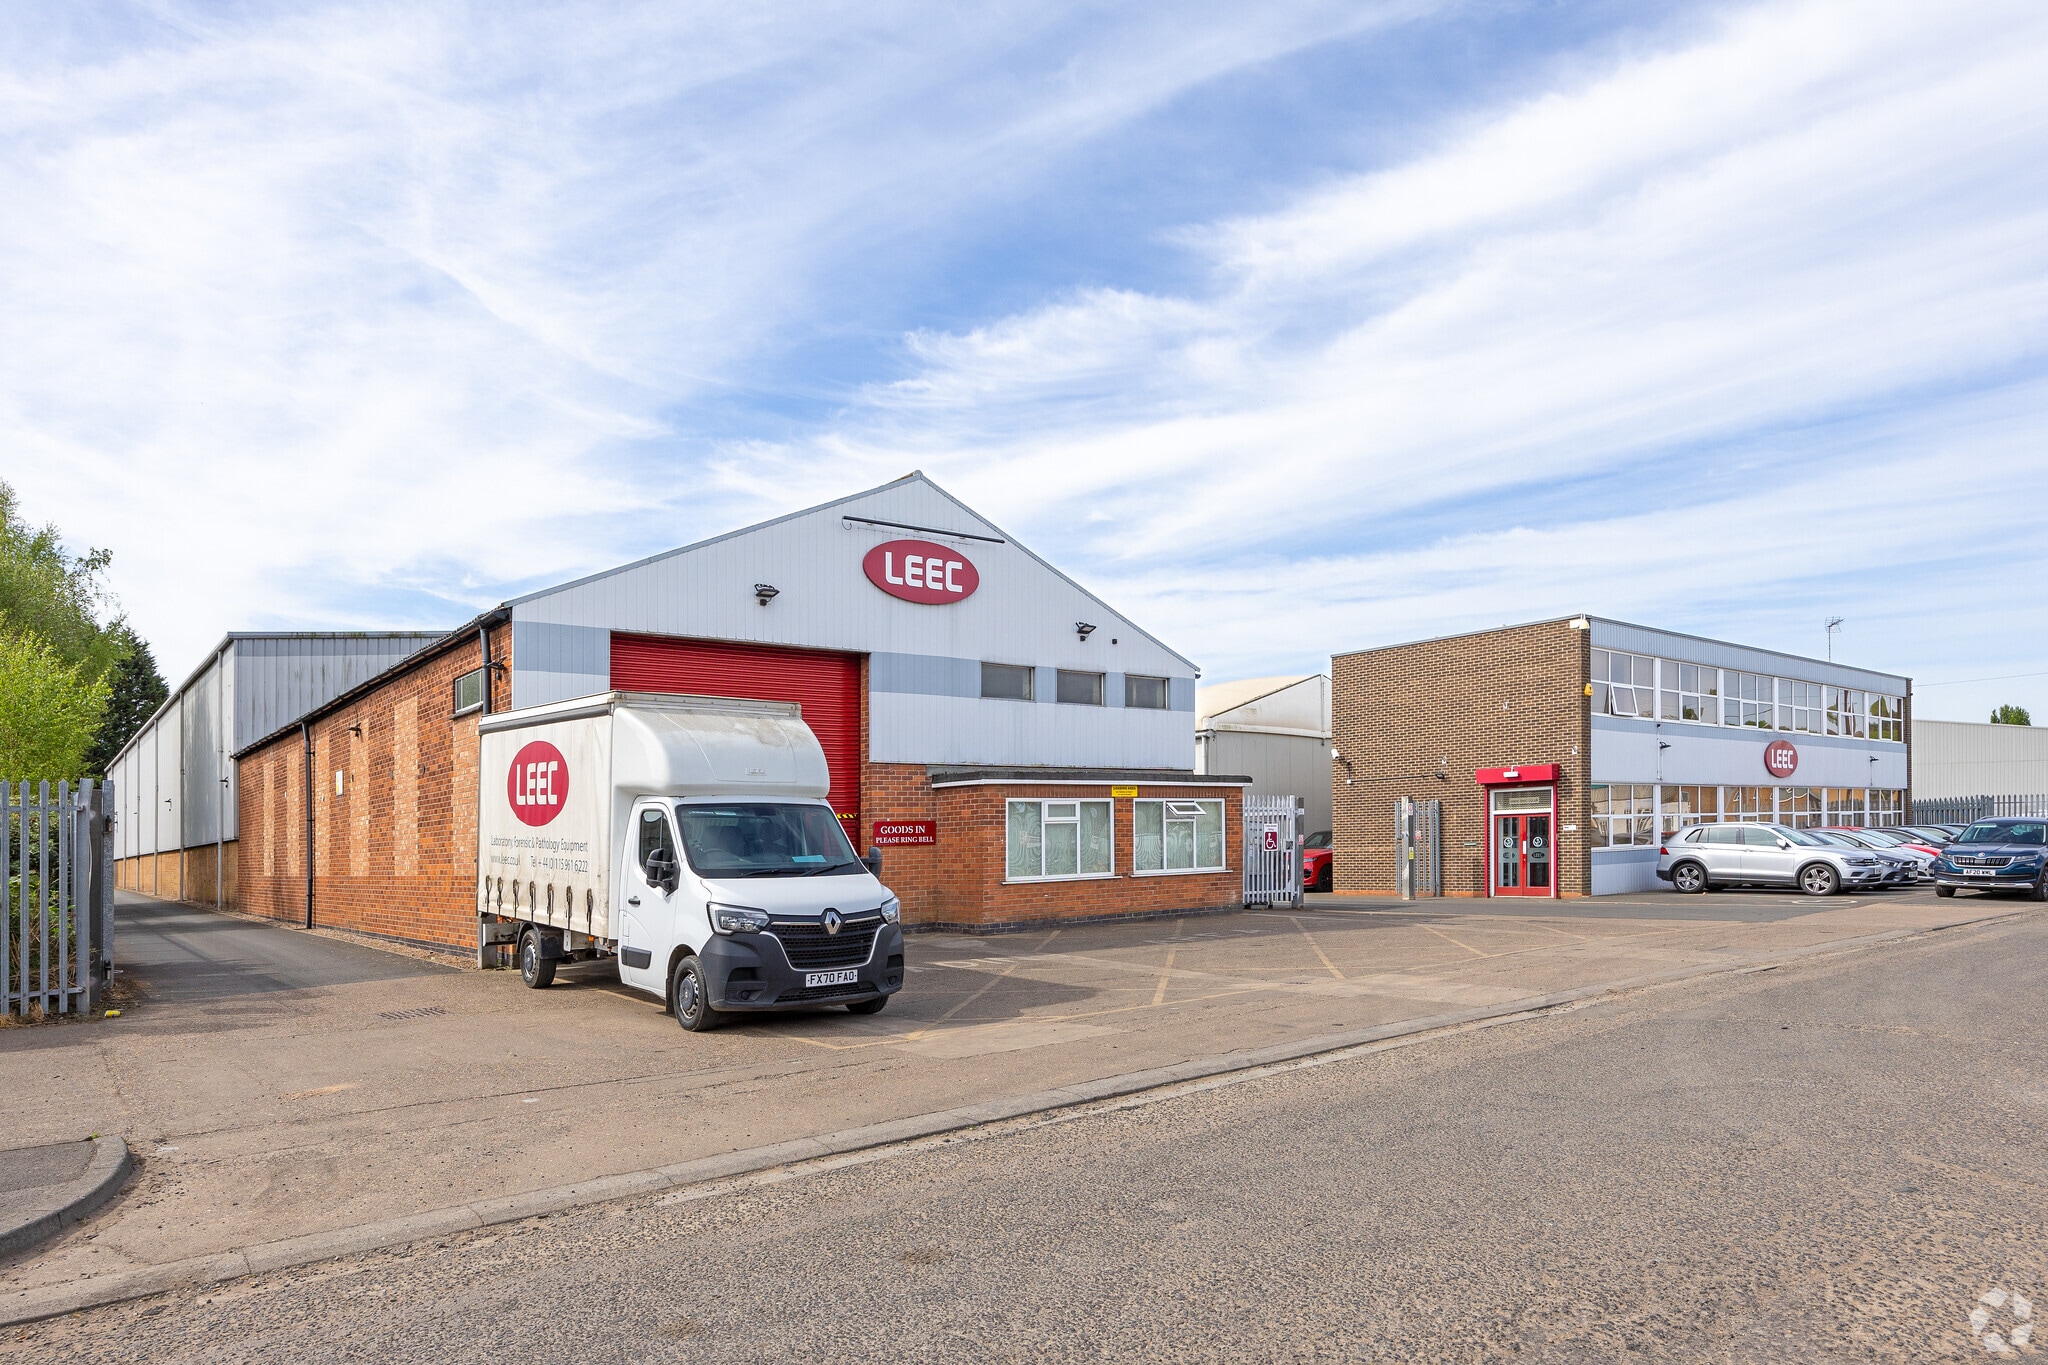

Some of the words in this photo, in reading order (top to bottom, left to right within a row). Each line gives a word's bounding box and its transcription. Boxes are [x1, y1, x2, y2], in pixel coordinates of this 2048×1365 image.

[885, 552, 963, 593] LEEC
[1771, 749, 1794, 769] LEEC
[516, 760, 558, 806] LEEC
[880, 825, 914, 835] GOODS
[915, 825, 926, 834] IN
[514, 836, 531, 849] Forensic
[536, 837, 560, 853] Pathology
[561, 838, 588, 854] Equipment
[875, 836, 900, 844] PLEASE
[918, 835, 935, 843] BELL
[564, 859, 574, 871] 961
[810, 973, 835, 985] FX70
